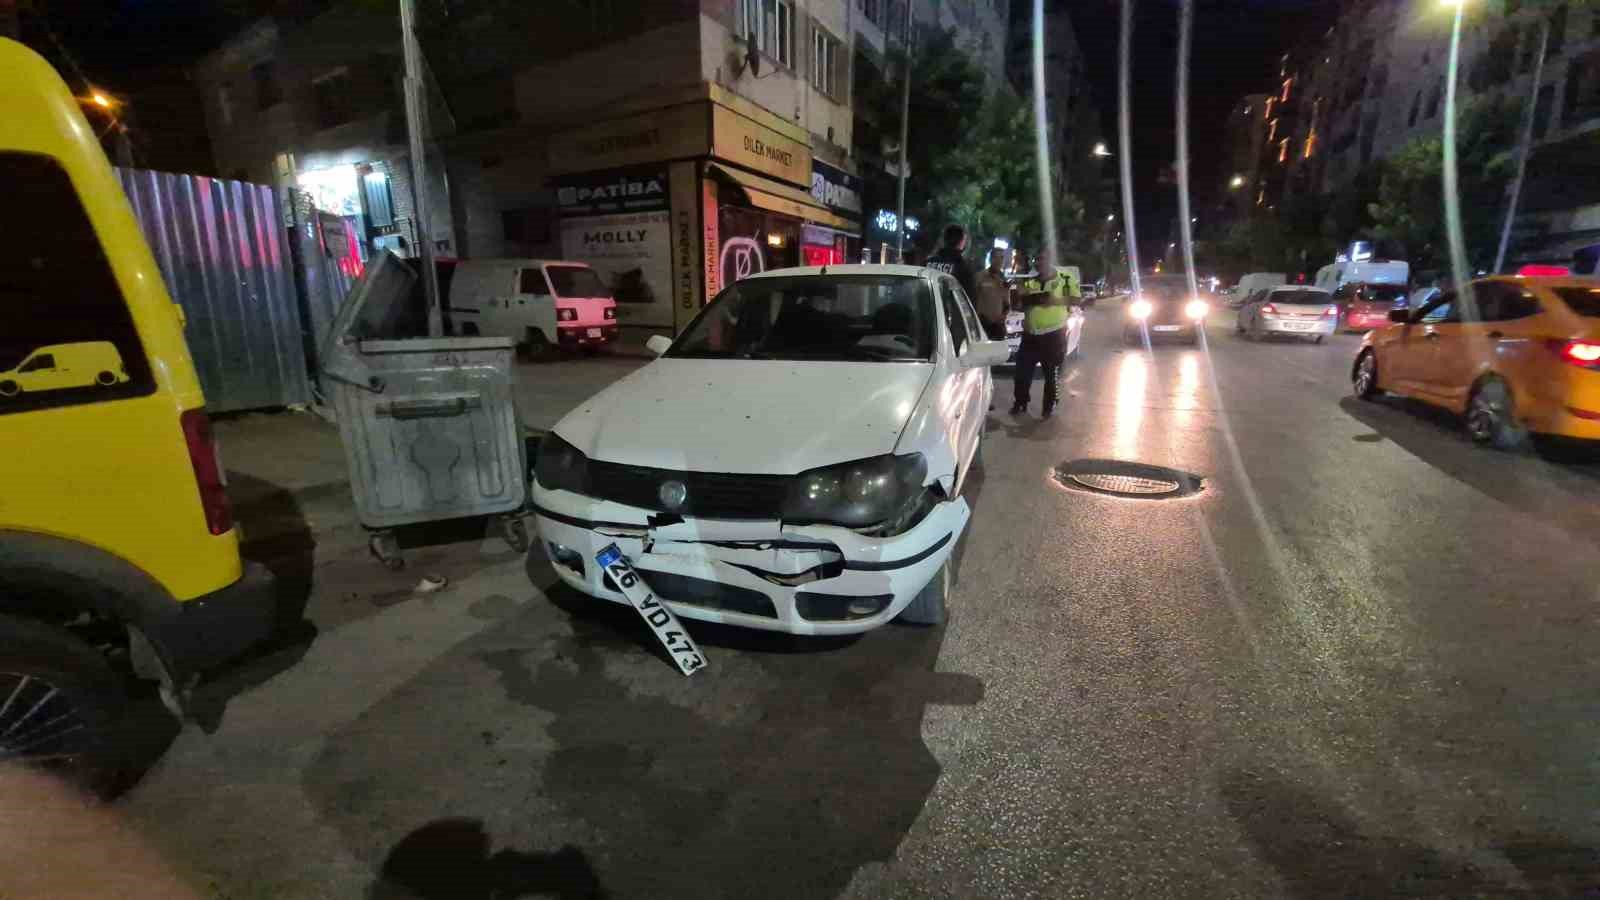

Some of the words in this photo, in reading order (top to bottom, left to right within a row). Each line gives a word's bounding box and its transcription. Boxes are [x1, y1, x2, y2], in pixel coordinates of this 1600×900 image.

[584, 229, 647, 244] MOLLY
[609, 558, 639, 588] 26
[640, 593, 670, 628] VD
[665, 631, 702, 670] 473
